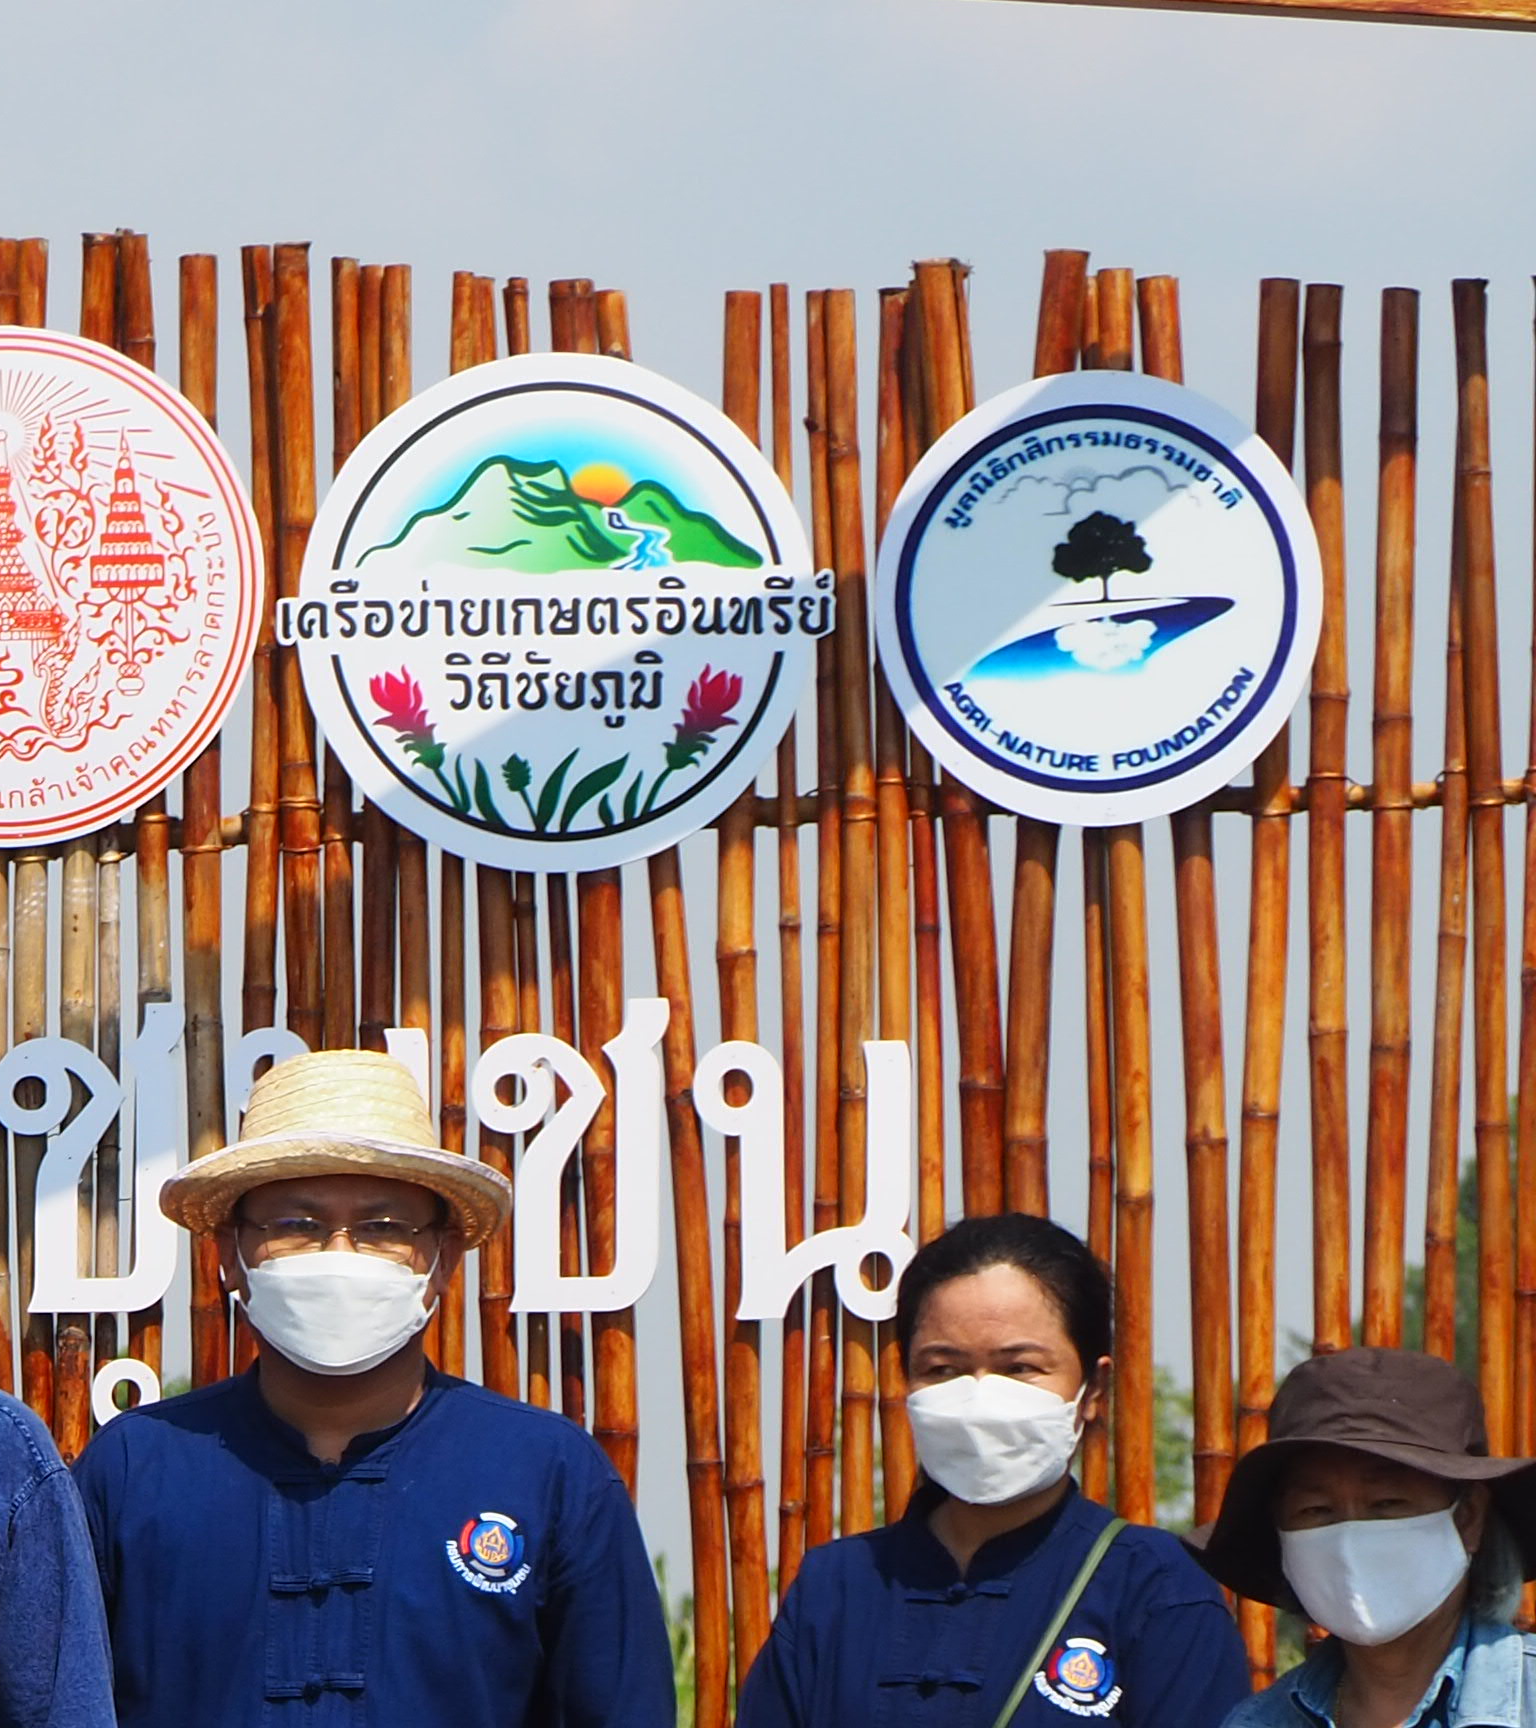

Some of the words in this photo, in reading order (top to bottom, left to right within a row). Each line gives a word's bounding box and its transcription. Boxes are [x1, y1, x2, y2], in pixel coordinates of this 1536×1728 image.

[944, 429, 1244, 530] มูลนิธิกสิกรรมธรรมชาติ
[280, 571, 831, 640] เครือข่ายเกษตรอินทรีย์
[444, 651, 665, 728] วิถีชัยภูมิ
[944, 680, 1099, 772] AGRI-NATURE
[1112, 666, 1255, 772] FOUNDATION
